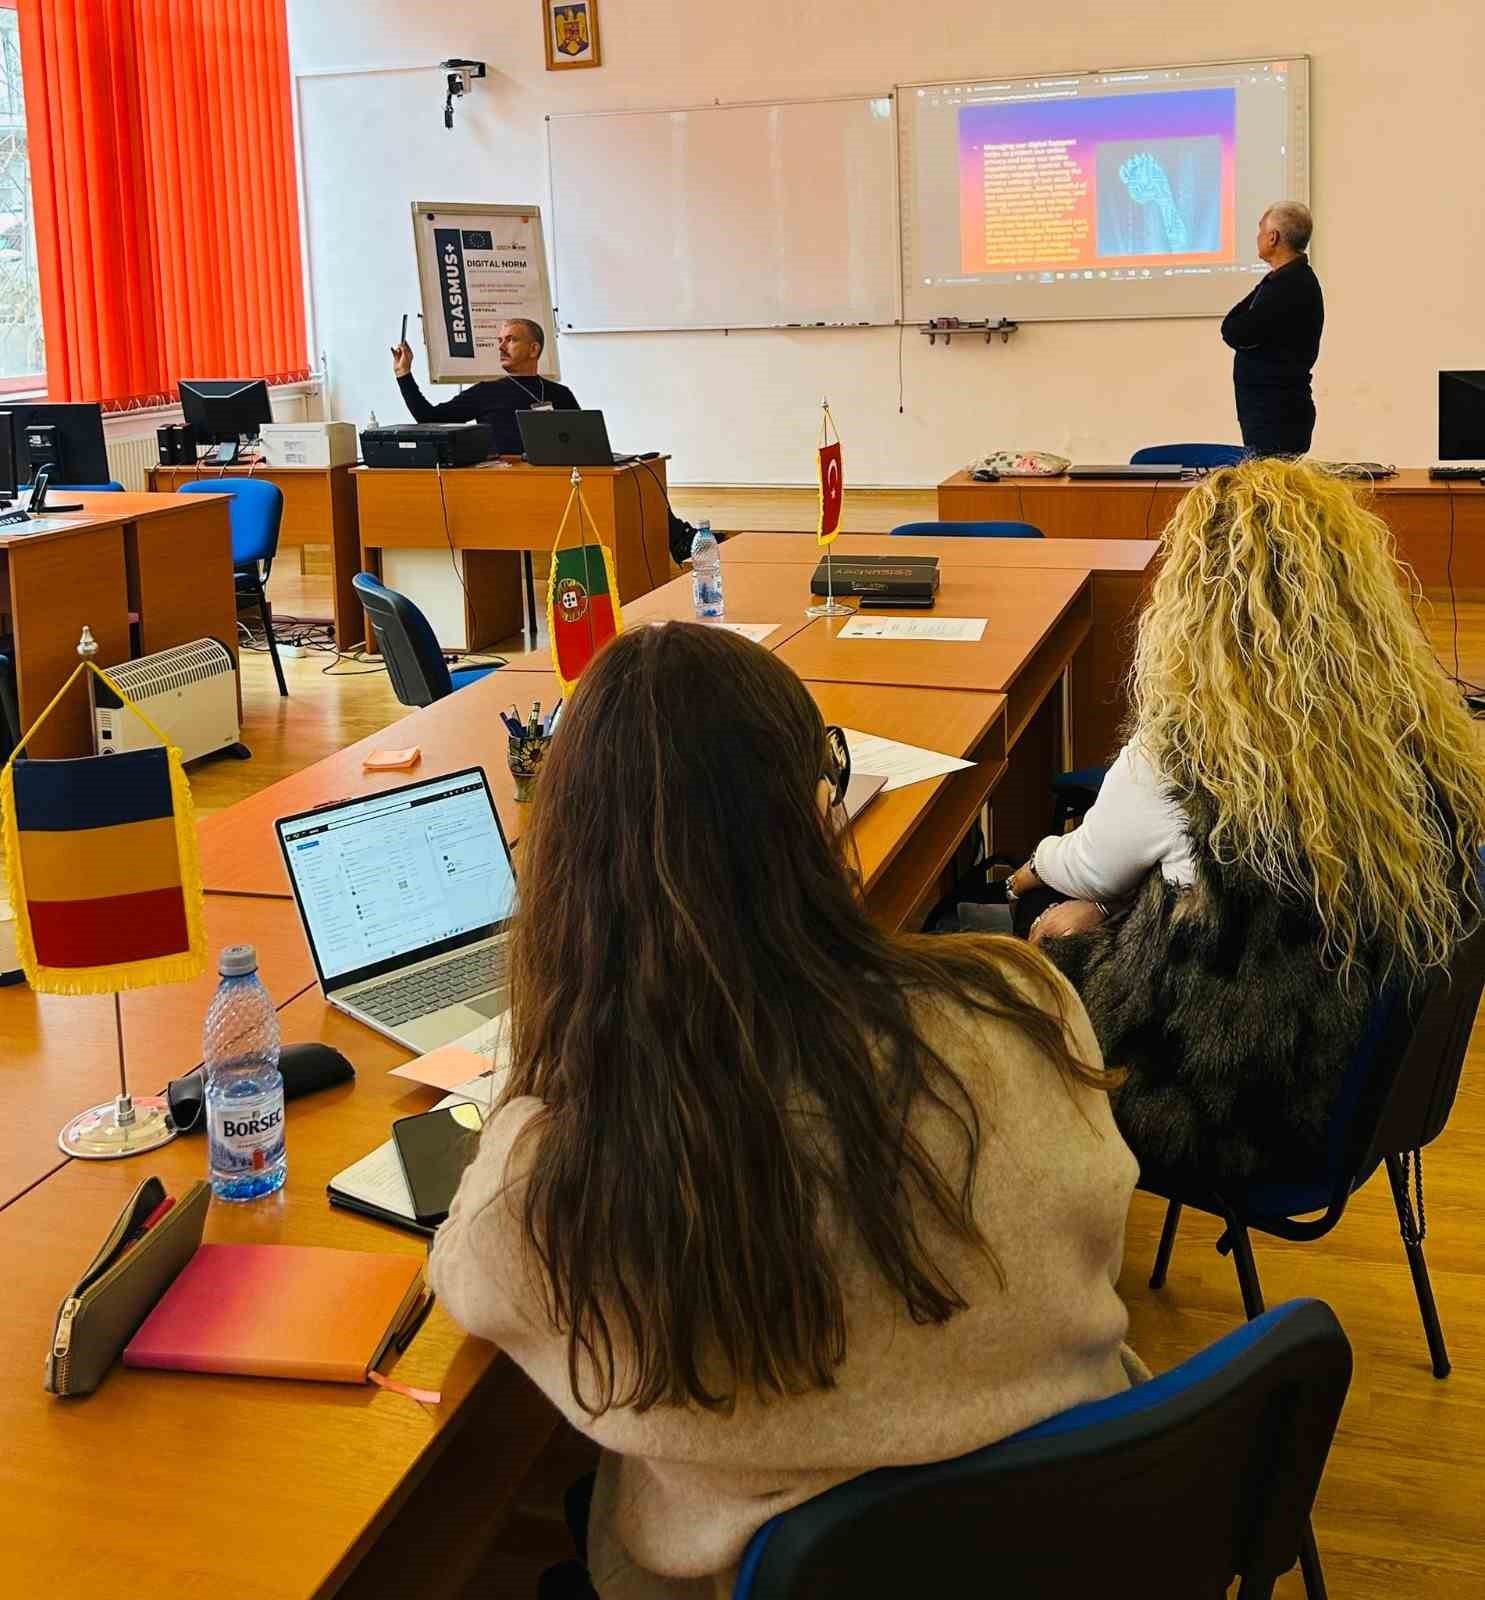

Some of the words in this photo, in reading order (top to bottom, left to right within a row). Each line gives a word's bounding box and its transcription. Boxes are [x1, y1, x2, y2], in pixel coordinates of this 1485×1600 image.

[467, 259, 500, 267] DIGITAL
[502, 260, 527, 268] NORM
[444, 243, 467, 343] ERASMUS+
[223, 1108, 282, 1137] BORSEC
